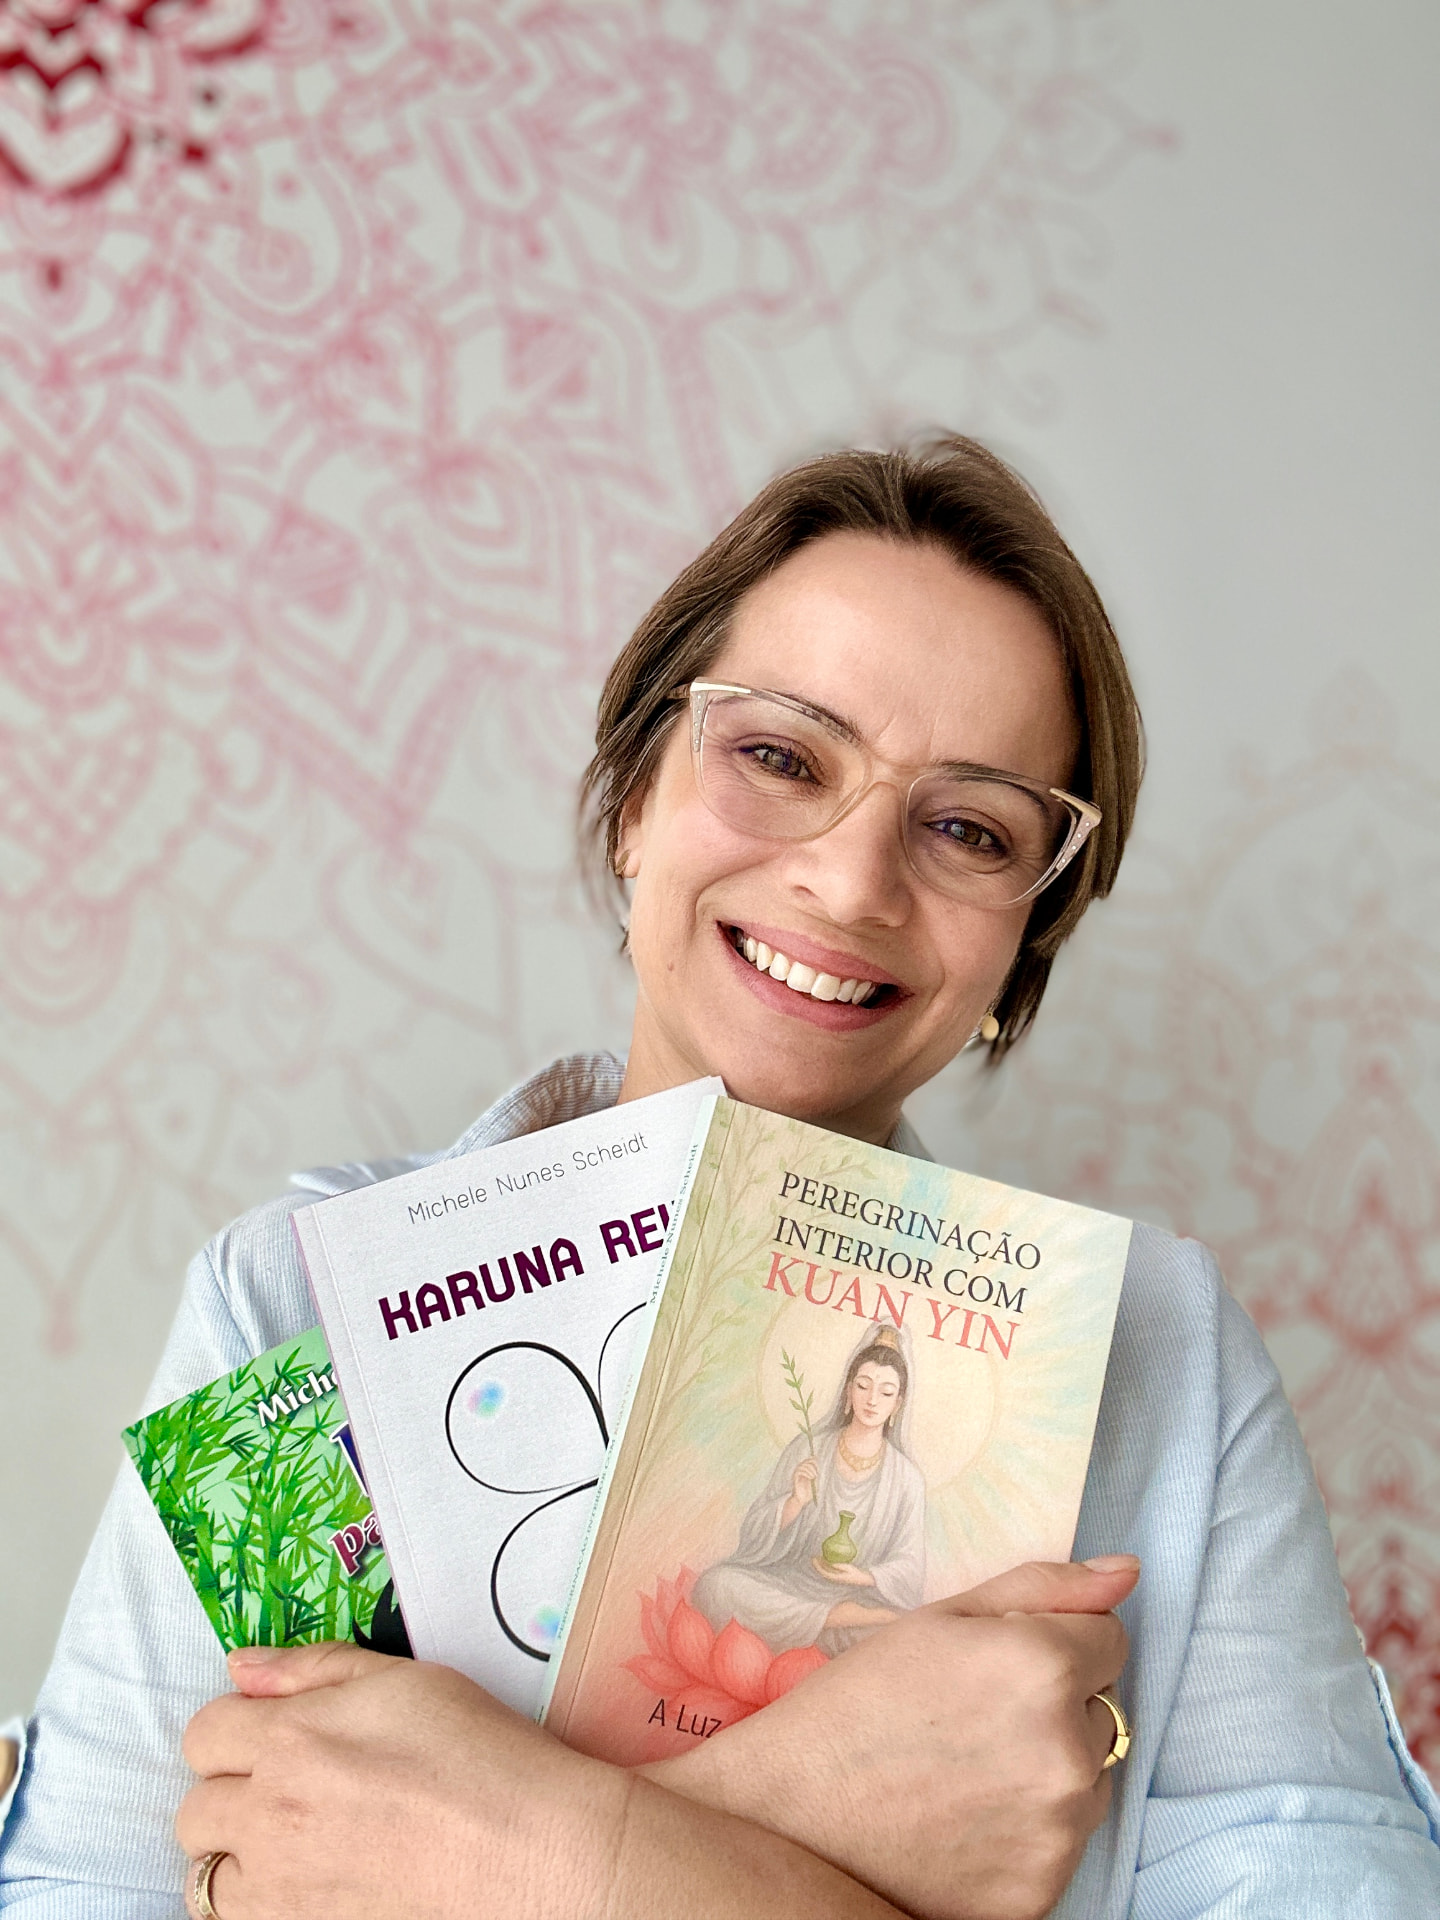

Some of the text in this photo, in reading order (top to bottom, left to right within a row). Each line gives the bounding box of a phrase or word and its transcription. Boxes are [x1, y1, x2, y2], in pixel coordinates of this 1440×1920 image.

[406, 1132, 648, 1225] Michele Nunes Scheidt
[778, 1171, 1042, 1270] PEREGRINAÇÃO
[378, 1237, 585, 1340] KARUNA
[762, 1251, 1021, 1360] KUAN YIN
[772, 1215, 1028, 1313] INTERIOR COM
[648, 1698, 666, 1727] A
